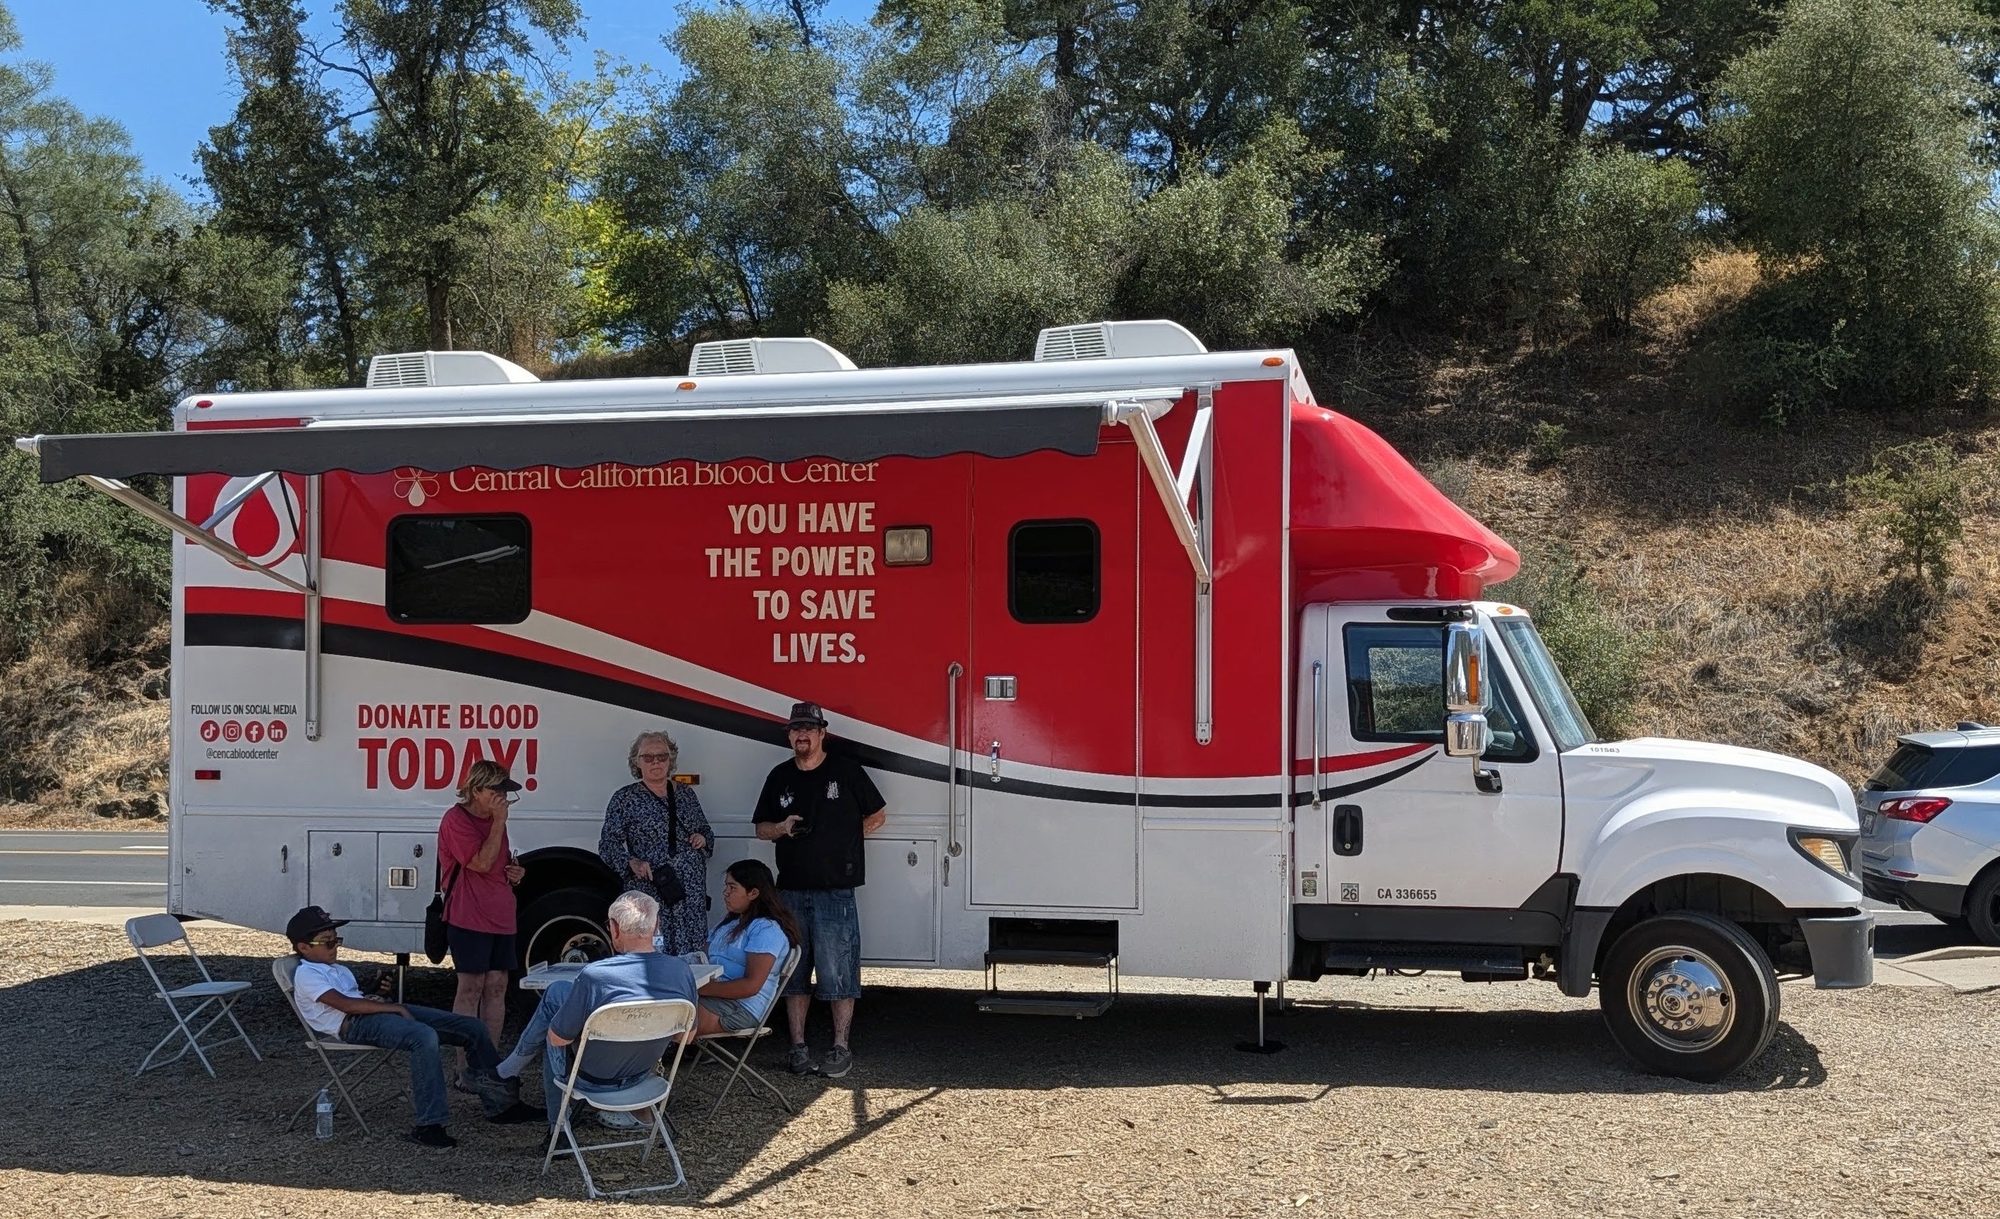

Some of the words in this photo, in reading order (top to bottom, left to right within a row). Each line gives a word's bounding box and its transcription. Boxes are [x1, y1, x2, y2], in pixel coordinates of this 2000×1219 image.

[450, 466, 551, 492] Central
[555, 463, 689, 489] California
[693, 461, 775, 485] Blood
[780, 459, 879, 483] Center
[728, 504, 786, 534] YOU
[799, 502, 876, 533] HAVE
[705, 547, 761, 578] THE
[772, 546, 876, 577] POWER
[753, 590, 790, 620] TO
[801, 589, 876, 619] SAVE
[773, 632, 866, 663] LIVES.
[191, 704, 220, 715] FOLLOW
[222, 704, 231, 715] US
[233, 704, 244, 715] ON
[245, 704, 271, 715] SOCIAL
[273, 704, 297, 715] MEDIA
[358, 704, 451, 730] DONATE
[459, 704, 539, 730] BLOOD
[206, 748, 279, 760] @cencabloodcenter
[1343, 888, 1357, 901] 26
[1377, 888, 1392, 899] CA
[1395, 888, 1437, 900] 336655
